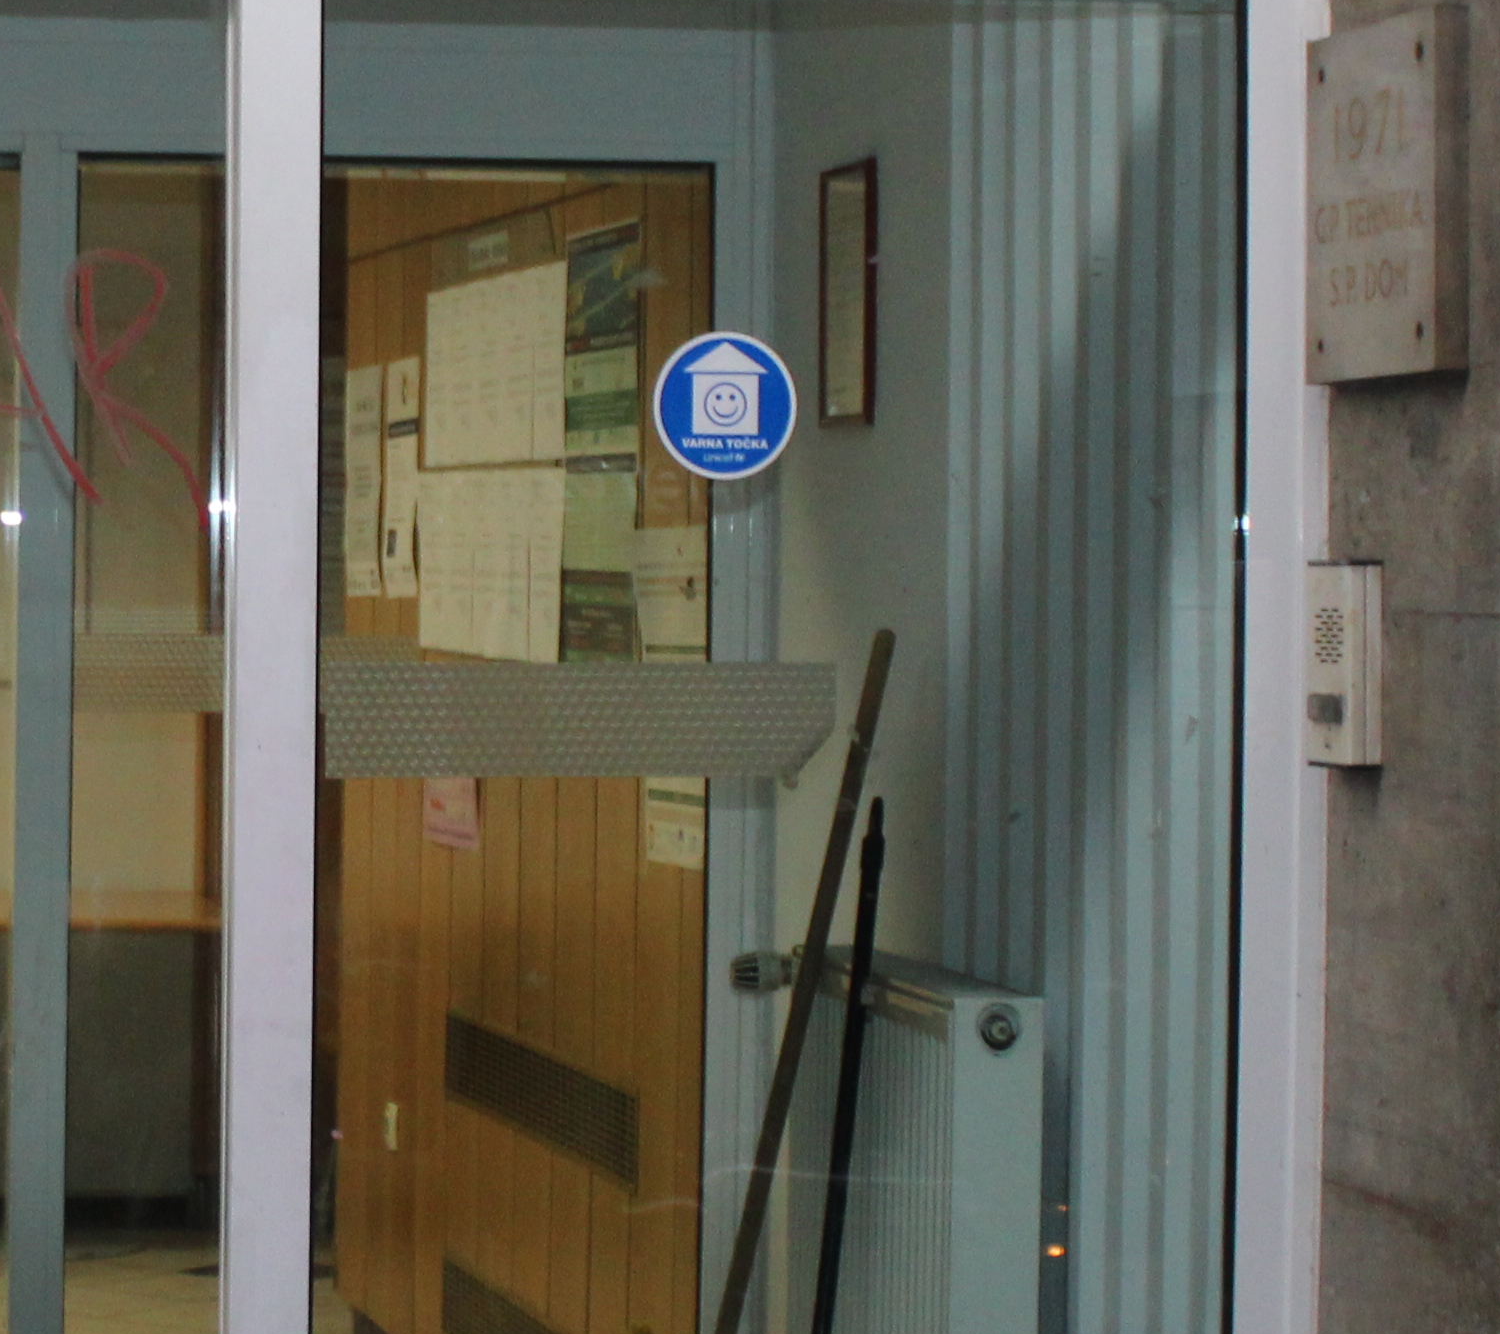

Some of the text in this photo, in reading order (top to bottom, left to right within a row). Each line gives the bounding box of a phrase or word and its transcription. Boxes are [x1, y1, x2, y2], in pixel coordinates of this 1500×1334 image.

[1332, 84, 1405, 164] 1971
[681, 436, 769, 450] VARNA TOČKA
